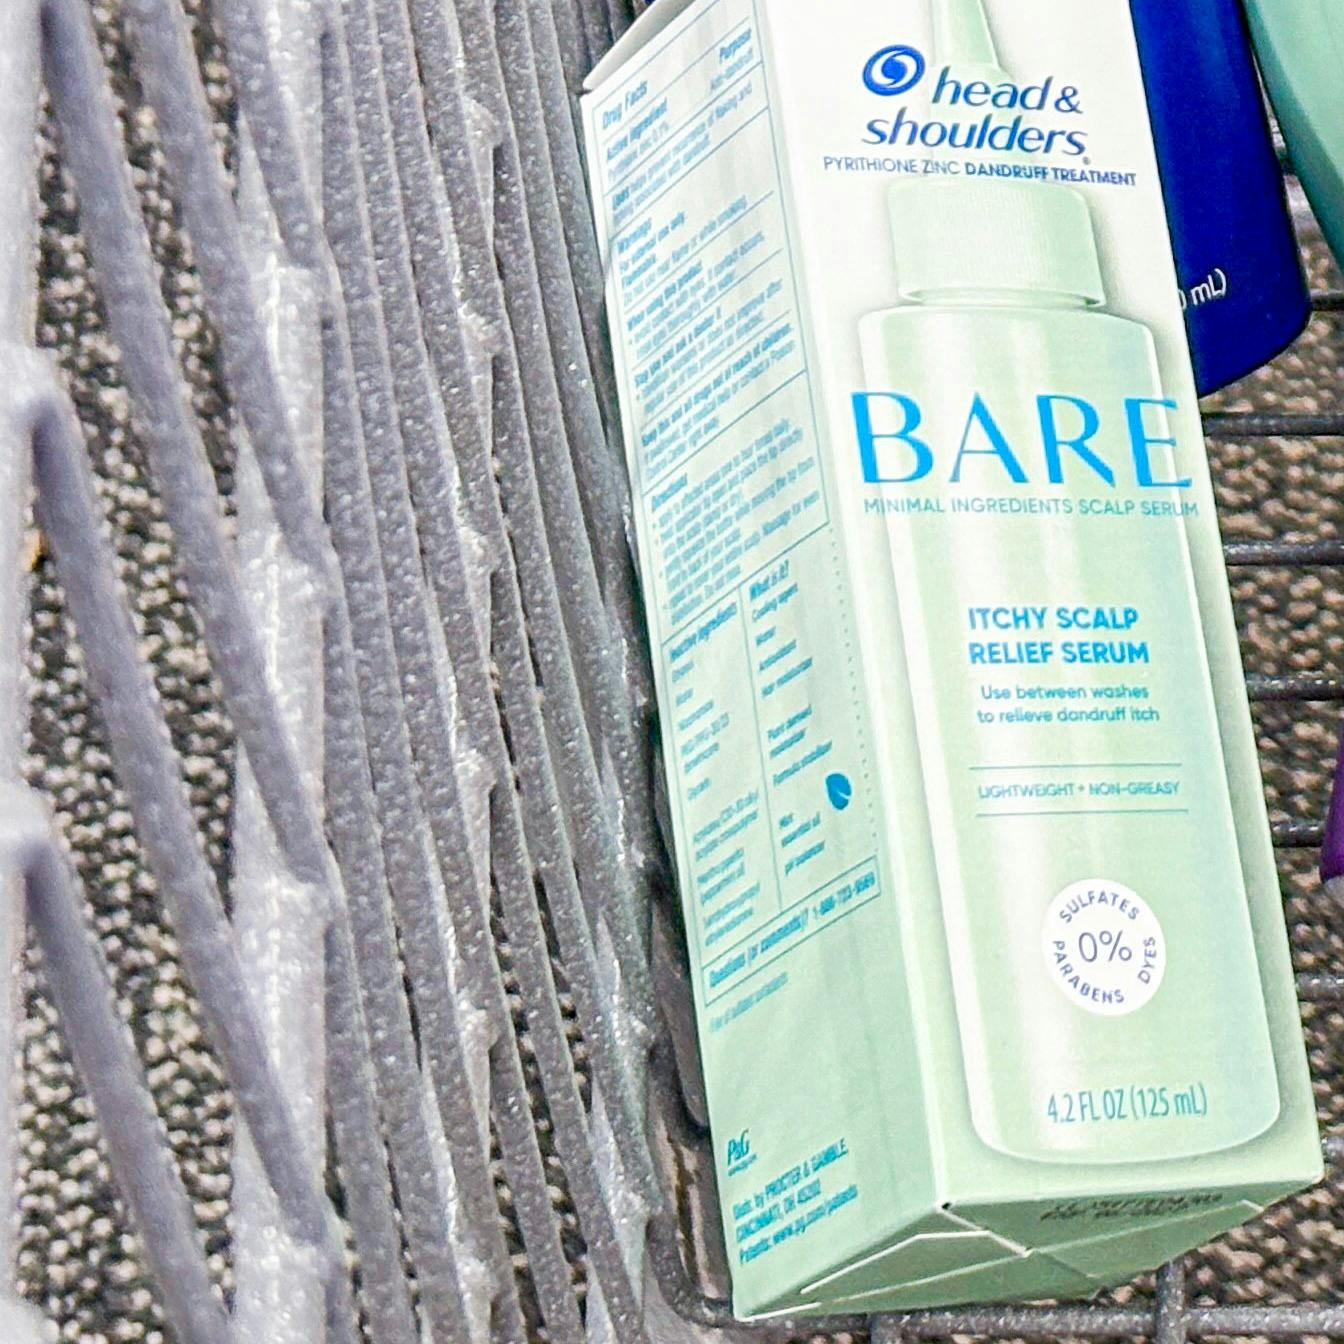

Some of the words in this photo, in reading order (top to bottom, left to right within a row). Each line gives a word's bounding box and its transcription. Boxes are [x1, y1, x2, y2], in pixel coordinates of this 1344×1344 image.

[823, 156, 919, 174] PYRITHIONE
[965, 162, 1048, 180] DANDRUFF
[1052, 167, 1136, 187] TREATMENT
[1190, 268, 1226, 306] mL)
[850, 390, 1193, 488] BARE
[863, 497, 944, 513] MINIMAL
[951, 497, 1073, 514] INGREDIENTS
[1079, 498, 1135, 515] SCALP
[1140, 500, 1199, 516] SERUM
[968, 607, 1048, 630] ITCHY
[1056, 607, 1139, 630] SCALP
[968, 641, 1054, 664] RELIEF
[1062, 641, 1150, 664] SERUM
[980, 684, 1011, 700] Use
[1016, 684, 1087, 700] between
[1092, 684, 1149, 700] washes
[999, 709, 1053, 723] relieve
[1057, 707, 1126, 723] dandruff
[1130, 707, 1160, 723] itch
[1059, 890, 1140, 924] SULFATES
[1078, 929, 1133, 963] 0%
[1137, 936, 1156, 984] DYES
[1052, 939, 1125, 1004] PARABENS
[1174, 1082, 1208, 1117] mL)
